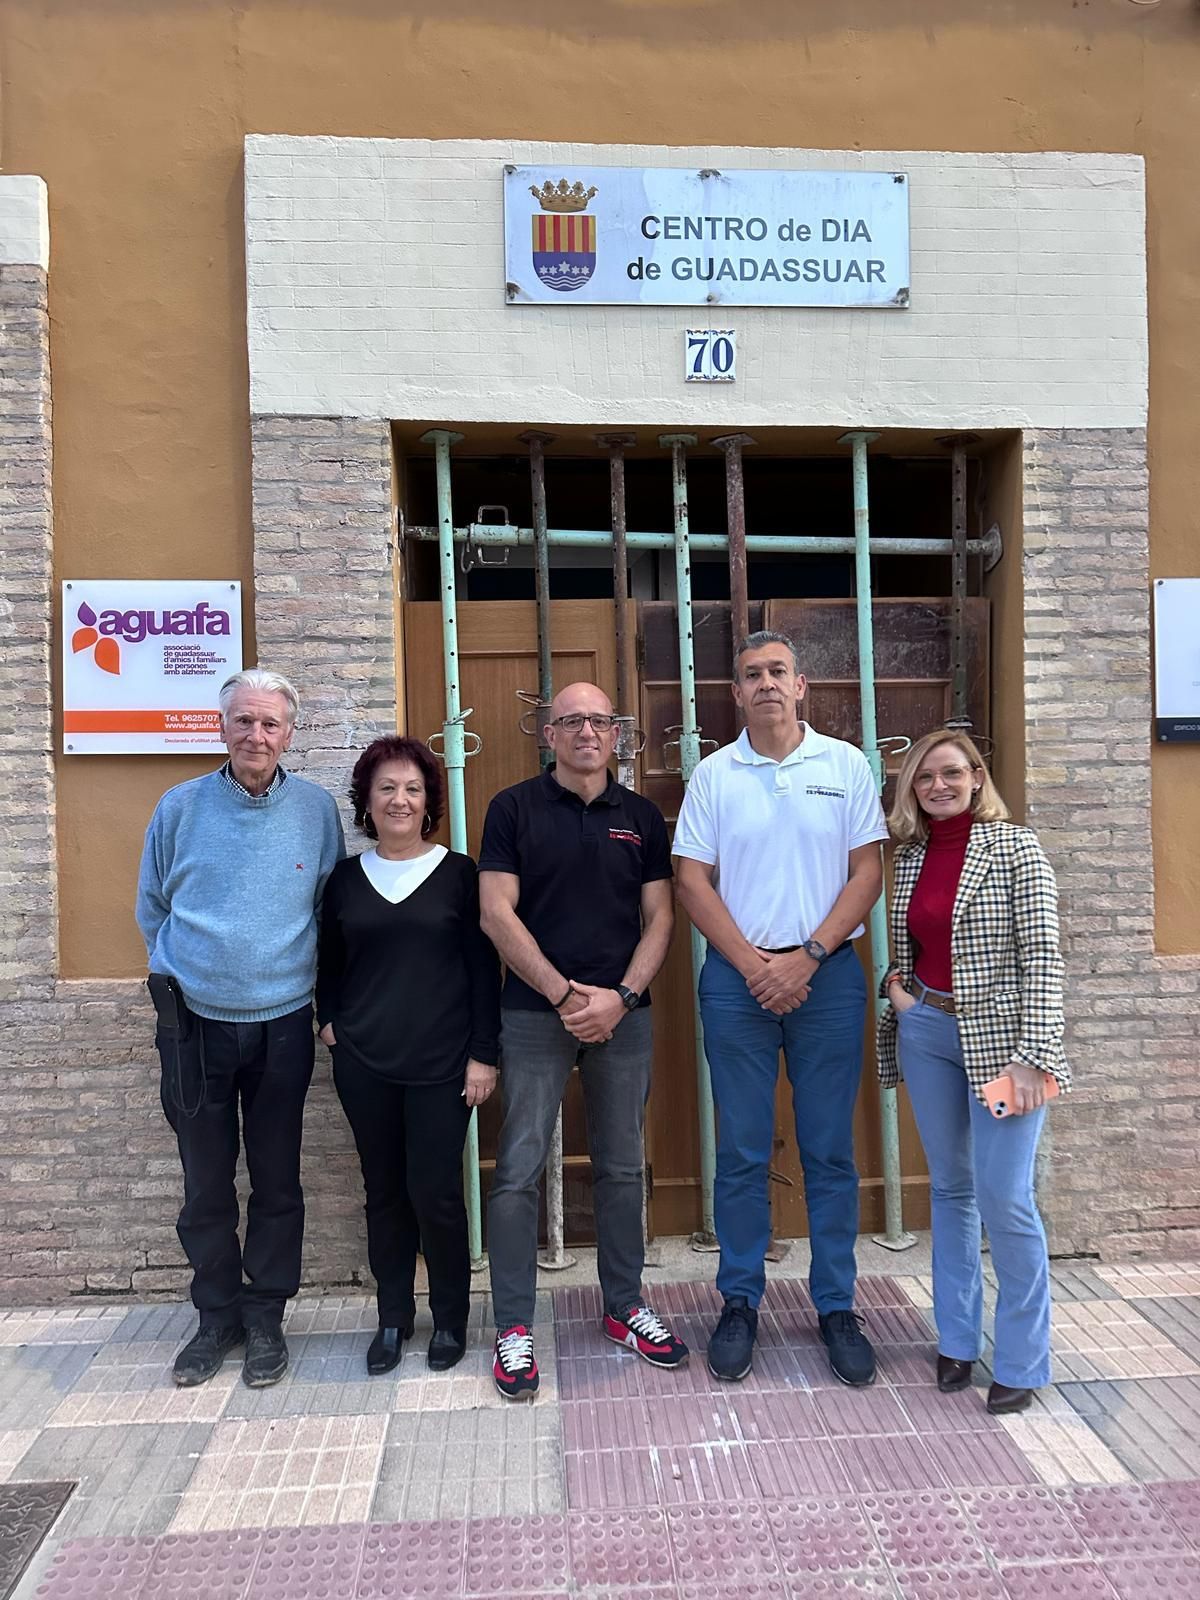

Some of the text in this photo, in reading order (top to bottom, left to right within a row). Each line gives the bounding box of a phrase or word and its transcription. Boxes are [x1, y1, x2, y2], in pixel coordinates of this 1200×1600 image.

[641, 215, 873, 243] CENTRO de DIA
[626, 257, 887, 283] de GUADASSUAR
[688, 337, 734, 373] 70
[98, 602, 230, 643] aguafa
[174, 650, 217, 658] guadassuar
[174, 663, 208, 671] persones
[164, 714, 219, 722] Tel. 9625707
[164, 721, 221, 730] www.aguafa.o
